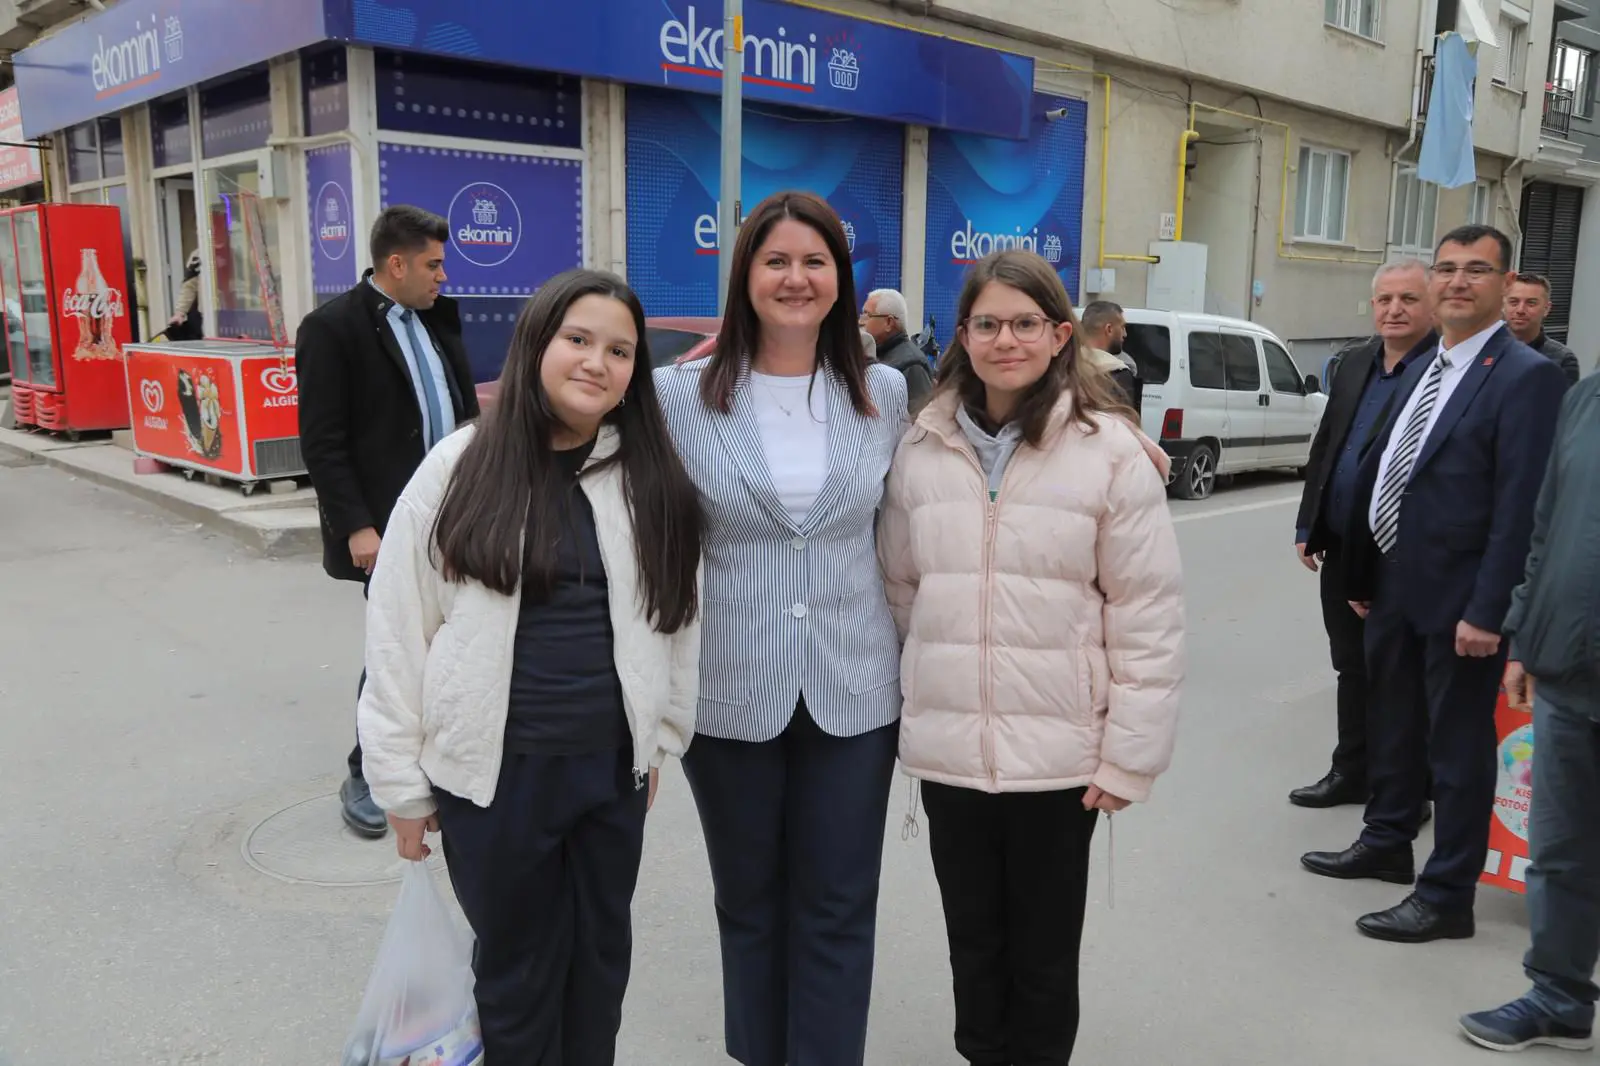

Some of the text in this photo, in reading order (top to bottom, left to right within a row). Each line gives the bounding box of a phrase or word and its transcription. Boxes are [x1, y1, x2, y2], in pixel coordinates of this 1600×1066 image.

[92, 13, 160, 91] ekomini
[458, 224, 512, 243] ekomini
[951, 219, 1037, 259] ekomini
